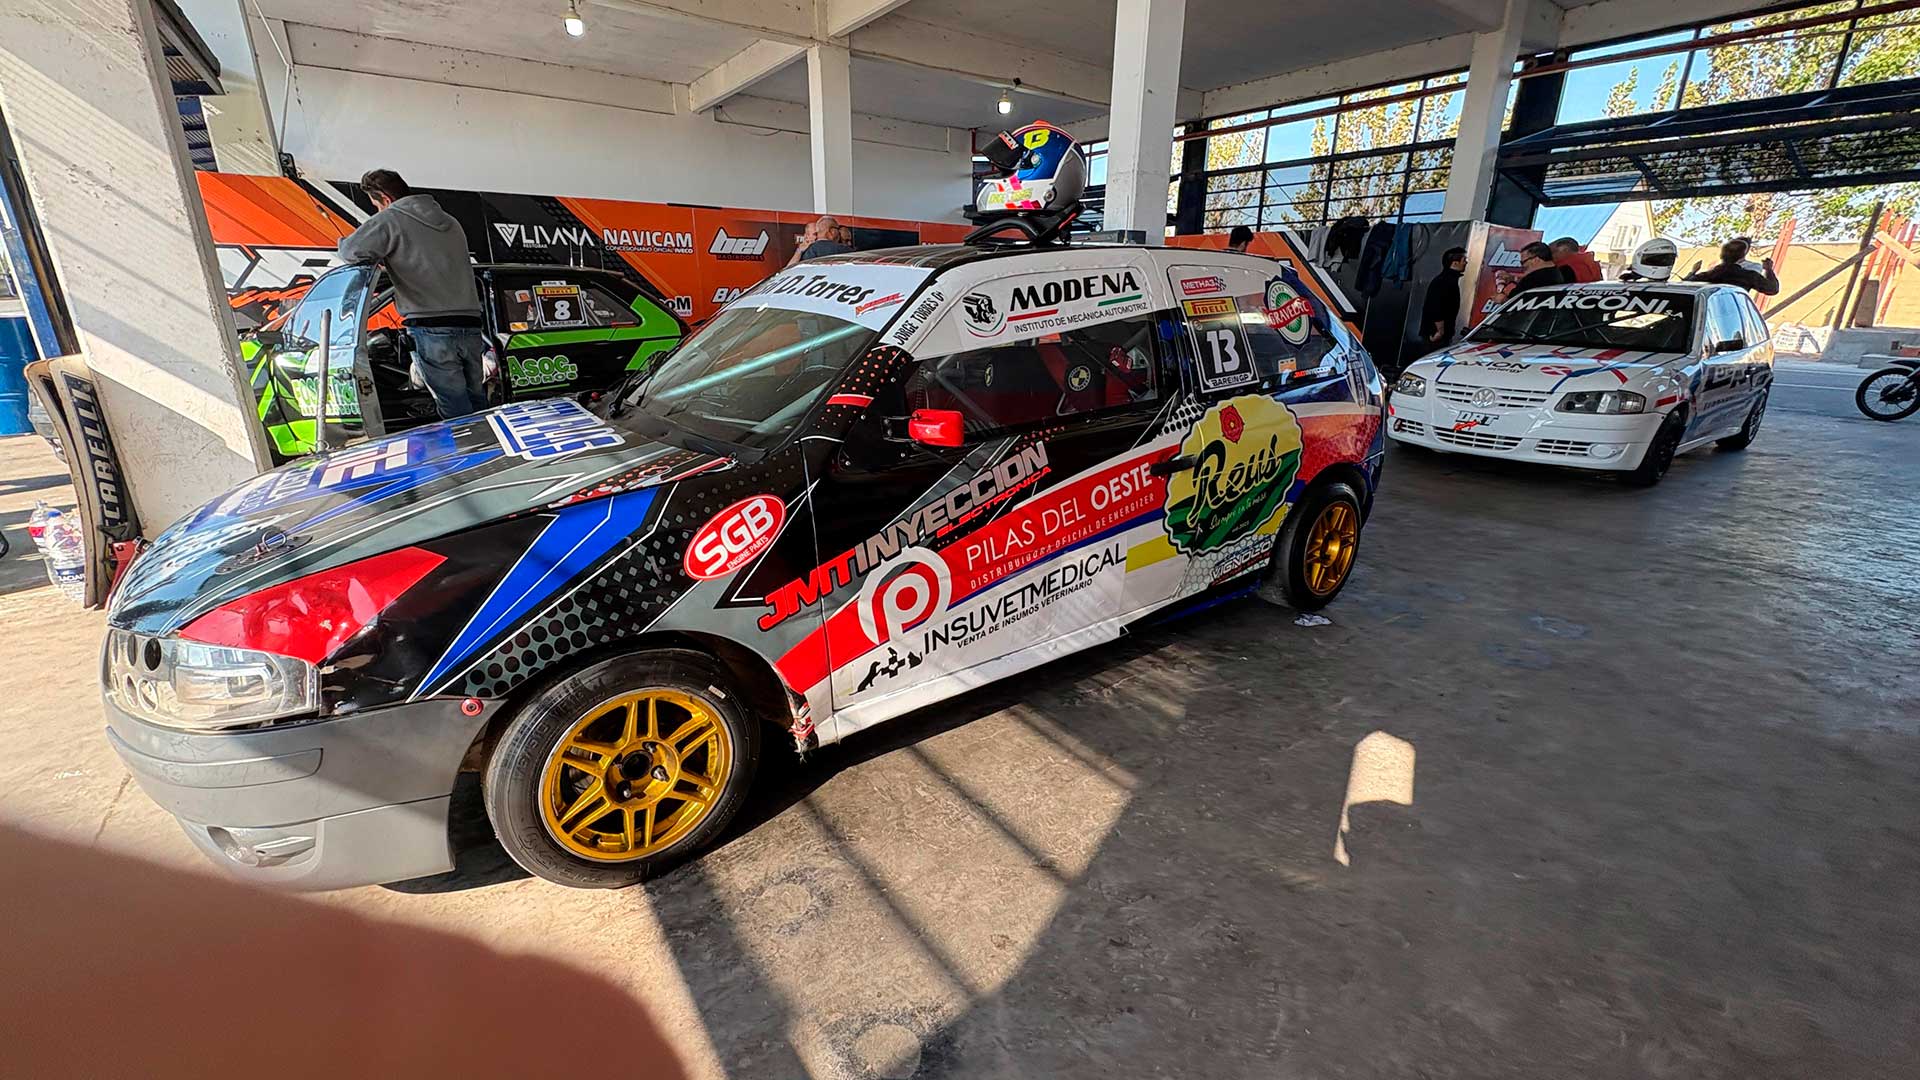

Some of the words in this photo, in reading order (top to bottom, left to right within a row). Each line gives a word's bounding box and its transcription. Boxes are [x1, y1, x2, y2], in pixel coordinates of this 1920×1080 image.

[603, 228, 693, 248] NAVICAM
[554, 300, 571, 320] 8
[1010, 271, 1140, 312] MODENA
[1190, 300, 1229, 314] PIRELLI
[1507, 295, 1670, 314] MARCONI
[893, 320, 919, 345] JORGE
[910, 298, 939, 323] TORRES
[1014, 318, 1055, 333] INSTITUTO
[1056, 317, 1067, 326] DE
[1104, 302, 1148, 316] AUTOMOTRIZ
[1206, 329, 1240, 374] 13
[936, 466, 1052, 539] ELECTRONICA
[966, 519, 1036, 571] PILAS
[1041, 497, 1086, 536] DEL
[1090, 462, 1153, 511] OESTE
[1055, 524, 1094, 547] OFICIAL
[1096, 517, 1107, 529] DE
[1108, 493, 1155, 523] ENERGIZER
[695, 499, 774, 576] SGB
[726, 548, 750, 570] ENGINE
[750, 535, 769, 553] PARTS
[924, 542, 1128, 655] INSUVETMEDICAL
[957, 631, 987, 648] VENTA
[988, 625, 1000, 634] DE
[1002, 604, 1040, 630] INSUMOS
[1041, 579, 1093, 608] VETERINARIO
